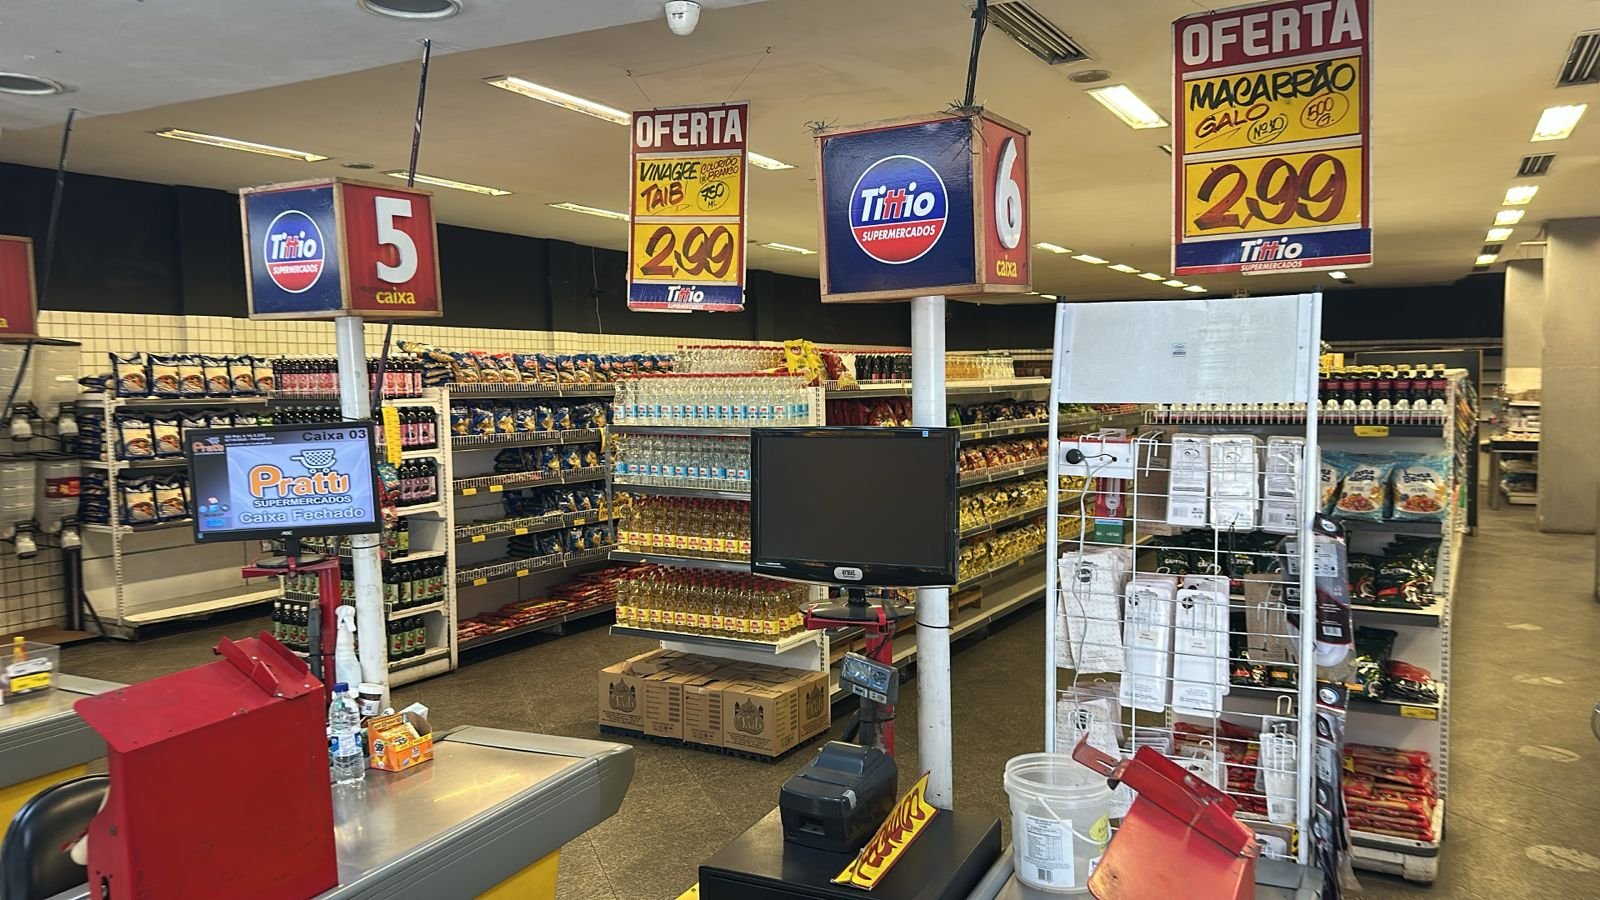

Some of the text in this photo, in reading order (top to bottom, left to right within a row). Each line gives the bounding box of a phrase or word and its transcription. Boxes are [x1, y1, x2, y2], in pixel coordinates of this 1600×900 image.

[1182, 0, 1363, 66] OFERTA
[1190, 60, 1356, 112] MACARRÃO
[1195, 103, 1270, 138] GALO
[1307, 97, 1334, 121] 500
[636, 108, 743, 148] OFERTA
[639, 161, 700, 182] VINAGRE
[701, 157, 737, 174] COLORIDO
[708, 165, 738, 182] BRANCO
[640, 181, 724, 213] TAIB 750
[860, 181, 935, 222] Tittio
[994, 136, 1023, 249] 6
[1193, 153, 1347, 230] 2,99
[271, 231, 317, 260] Tittio
[374, 196, 418, 284] 5
[861, 225, 936, 242] SUPERMERCADOS
[640, 225, 734, 279] 2,99
[1240, 236, 1303, 262] Tittio
[272, 262, 319, 276] SUPERMERCADOS
[996, 254, 1018, 278] caixa
[1240, 260, 1303, 272] SUPERMERCADOS
[375, 287, 416, 306] caixa
[667, 285, 704, 303] Tittio
[302, 429, 367, 442] Caixa 03
[254, 495, 352, 508] SUPERMERCADOS
[239, 507, 365, 524] Caixa Fechado
